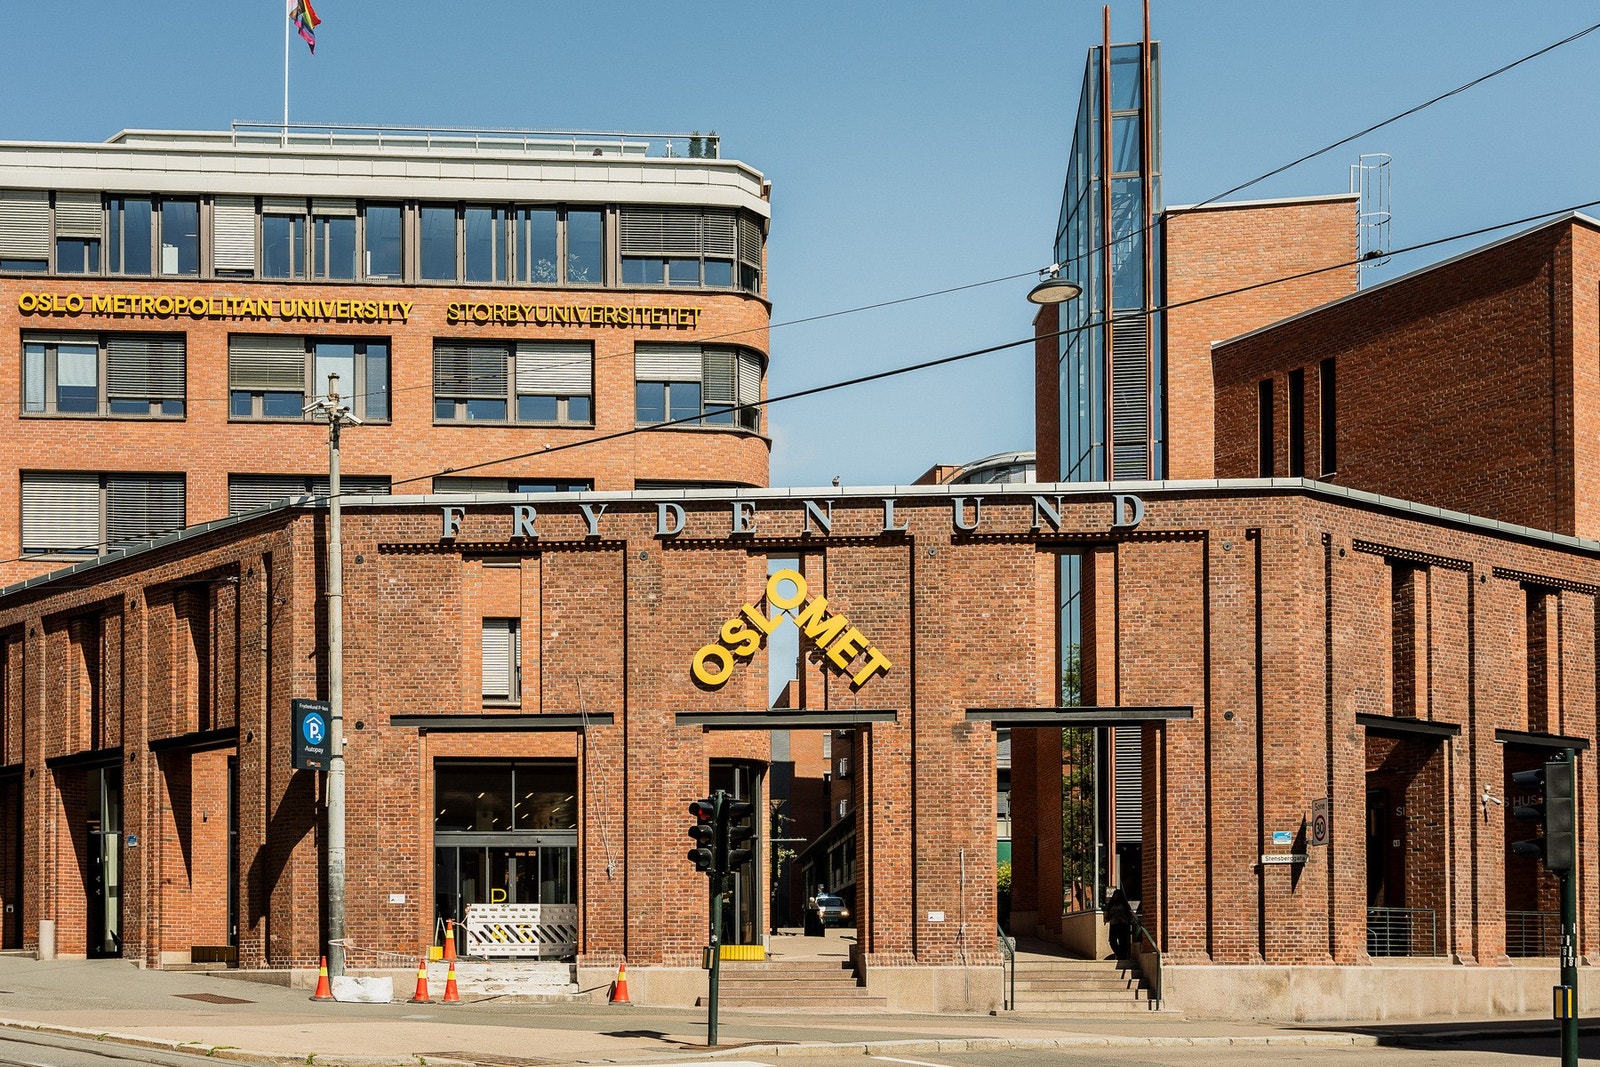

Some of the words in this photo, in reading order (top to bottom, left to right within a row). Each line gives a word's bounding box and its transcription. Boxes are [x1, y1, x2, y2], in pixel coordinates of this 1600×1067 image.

[18, 292, 84, 313] OSLO
[91, 294, 273, 317] METROPOLITAN
[280, 298, 413, 320] UNIVERSITY
[447, 301, 702, 325] STORBYUNIVERSITETET
[441, 494, 1144, 538] FRYDENLUND
